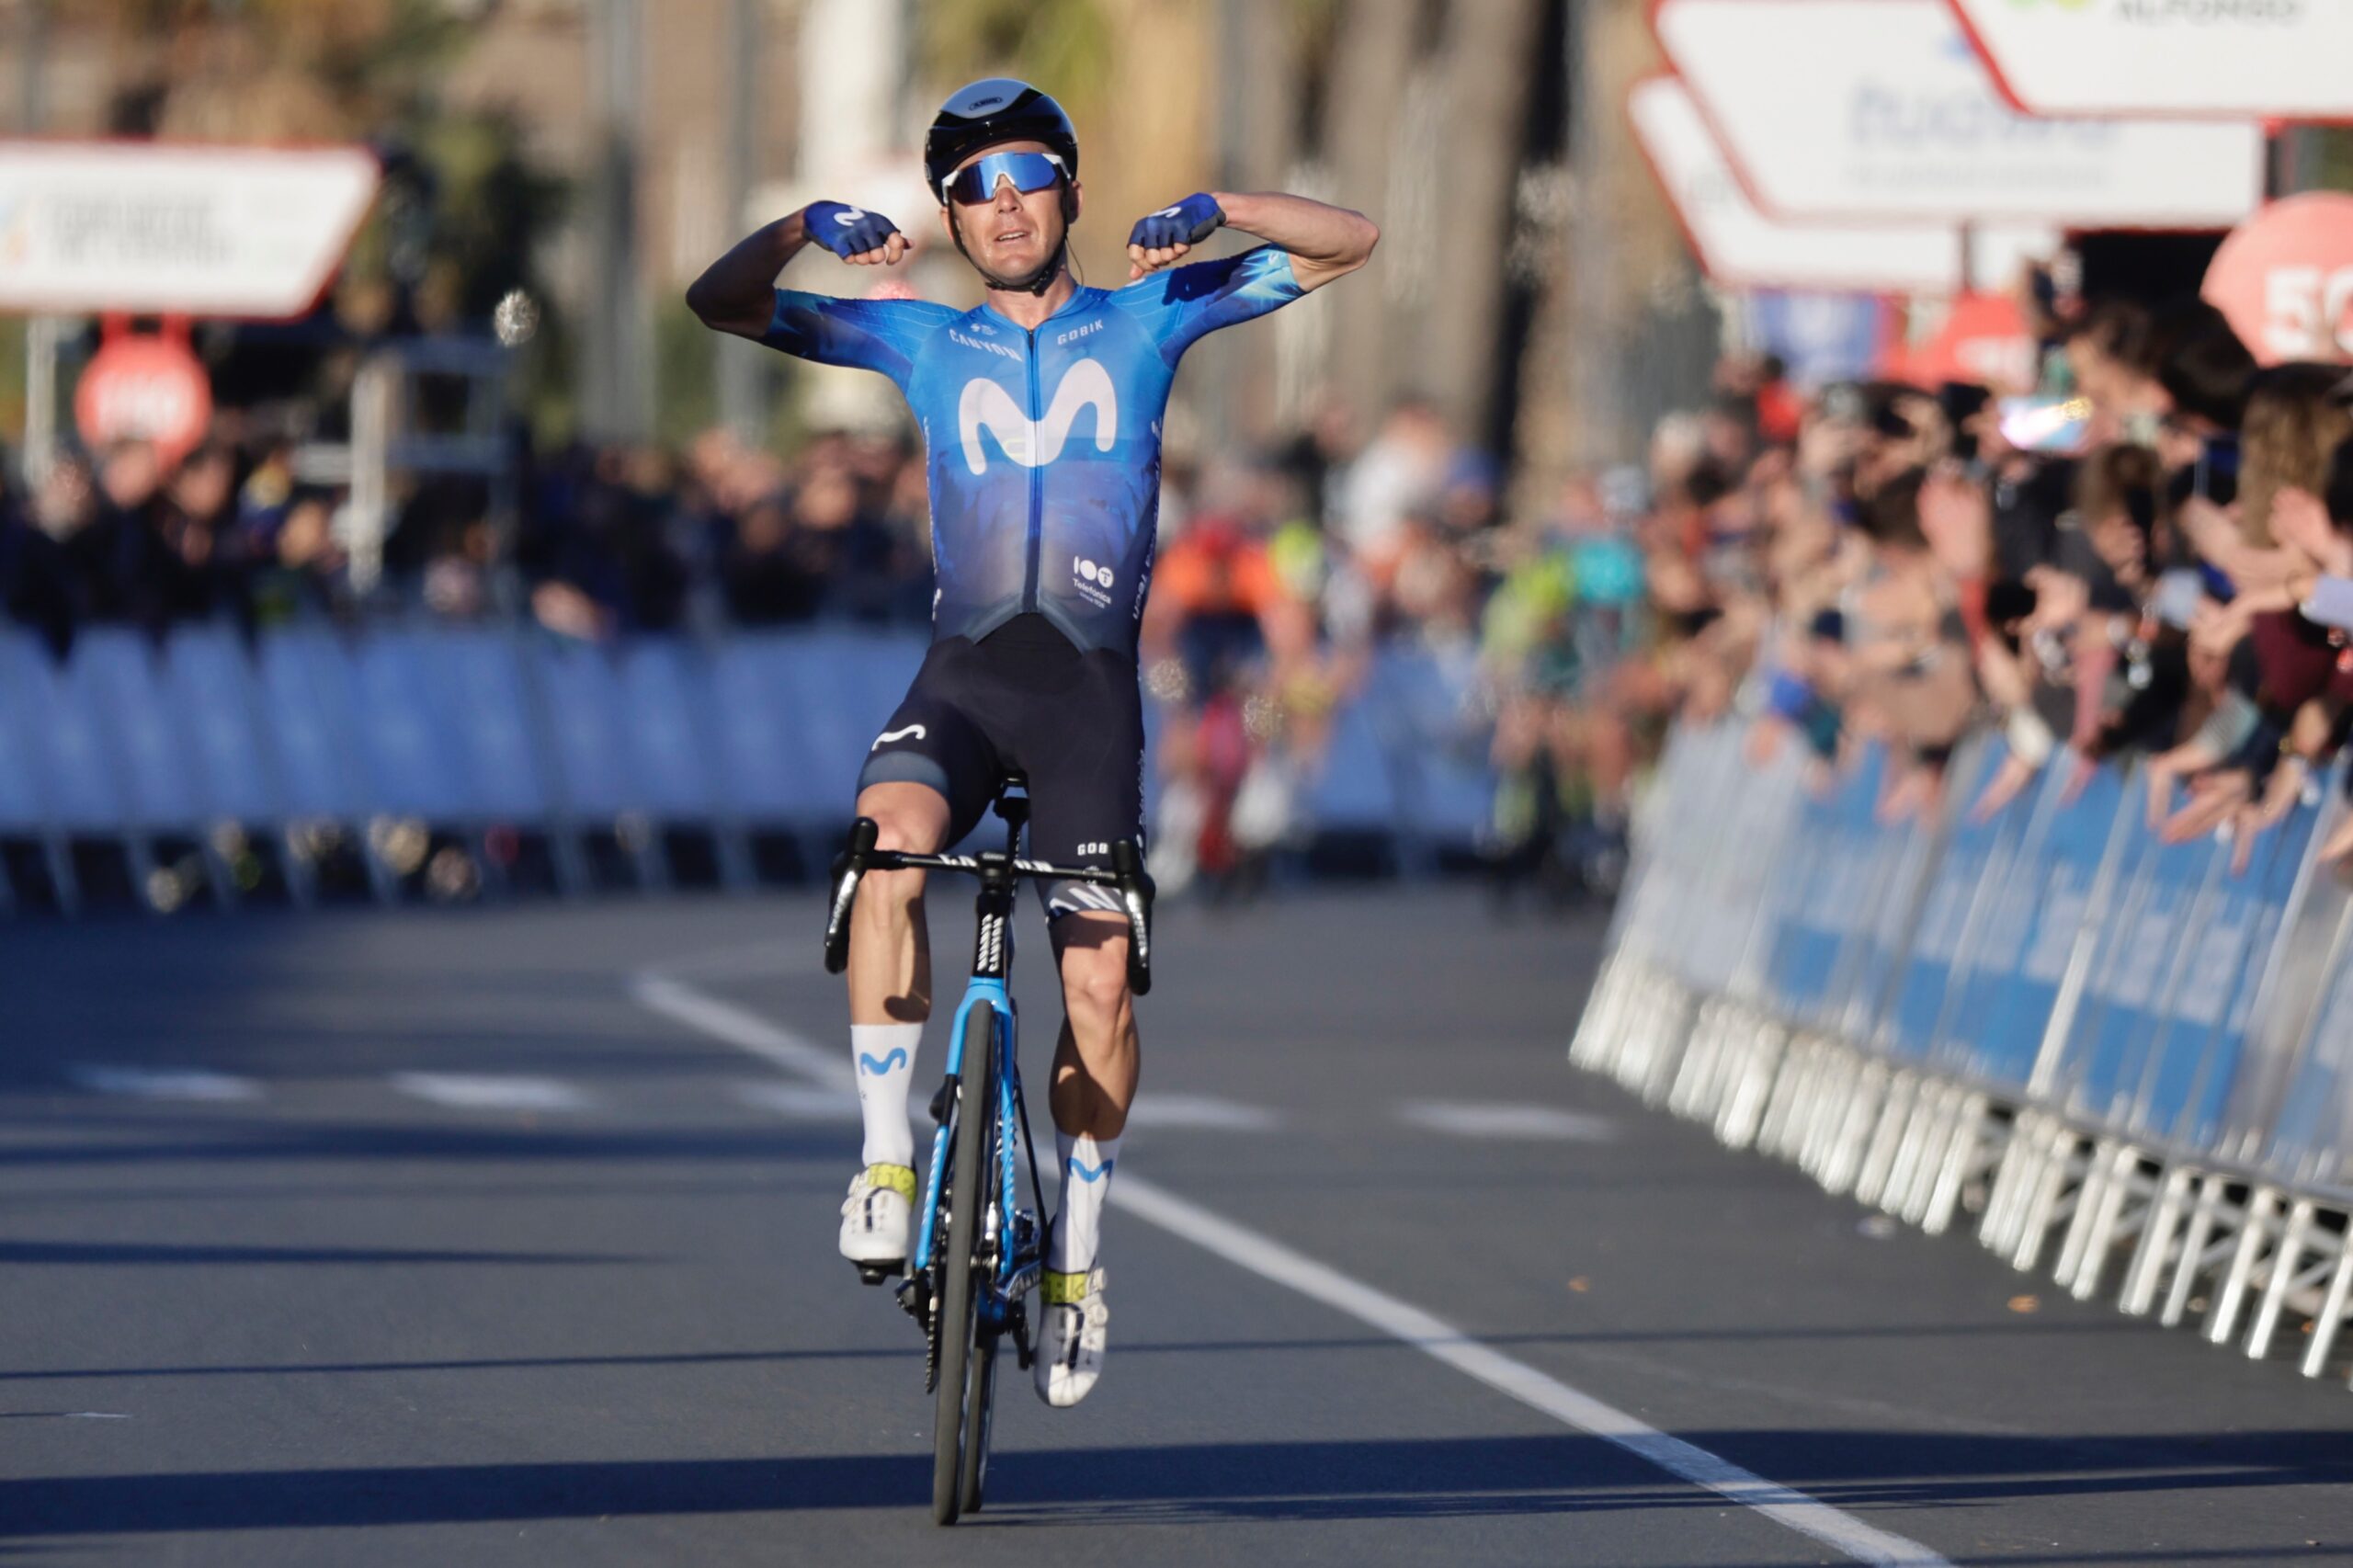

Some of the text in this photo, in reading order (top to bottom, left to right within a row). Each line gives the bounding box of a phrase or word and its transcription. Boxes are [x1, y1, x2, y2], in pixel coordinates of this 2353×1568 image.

[949, 328, 1023, 362] CANYON
[1057, 319, 1104, 346] GOBIK
[1077, 842, 1108, 856] GOB
